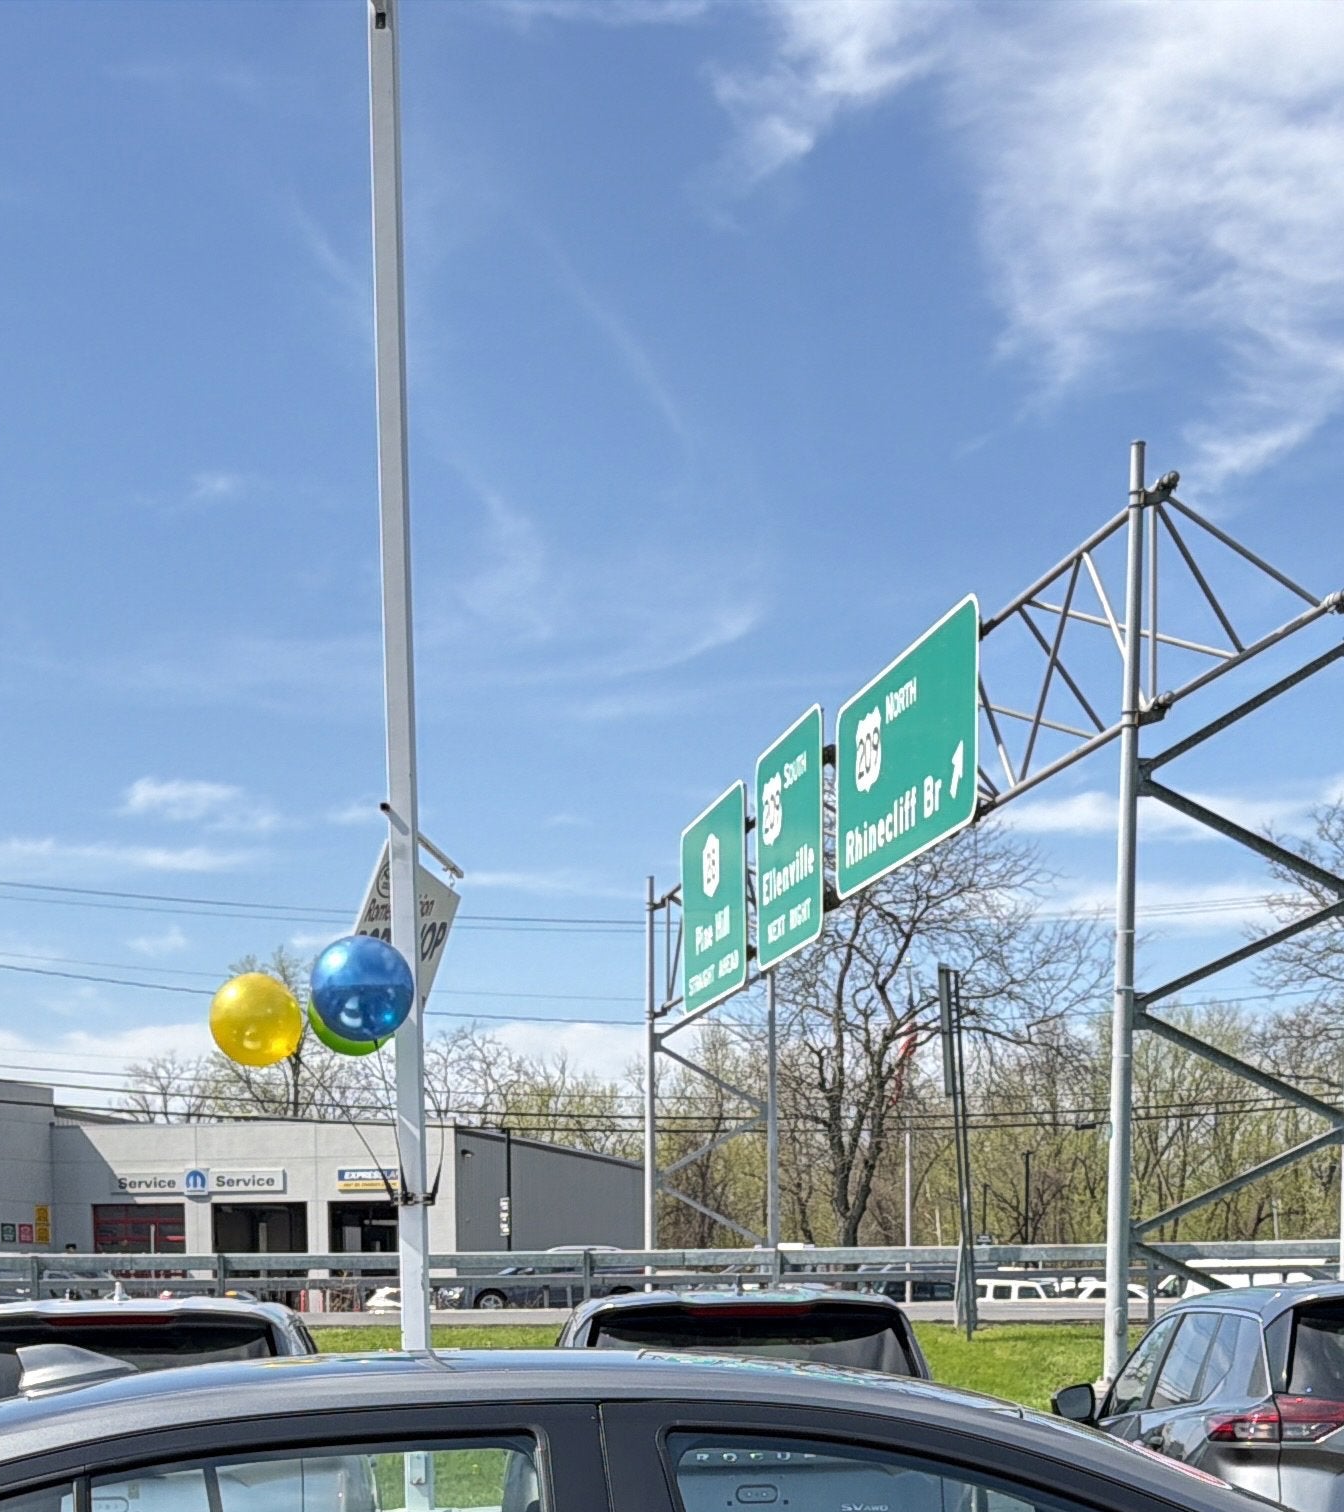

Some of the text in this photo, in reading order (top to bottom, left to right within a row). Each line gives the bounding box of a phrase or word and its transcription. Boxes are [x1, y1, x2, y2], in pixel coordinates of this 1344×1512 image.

[885, 676, 917, 725] NORTH
[783, 750, 807, 789] SOUTH
[857, 726, 880, 780] 209
[845, 775, 943, 869] Rhinecliff Br
[762, 843, 815, 906] Ellenville
[767, 896, 812, 945] NEXT RIGHT
[118, 1177, 176, 1190] Service
[216, 1174, 276, 1188] Service
